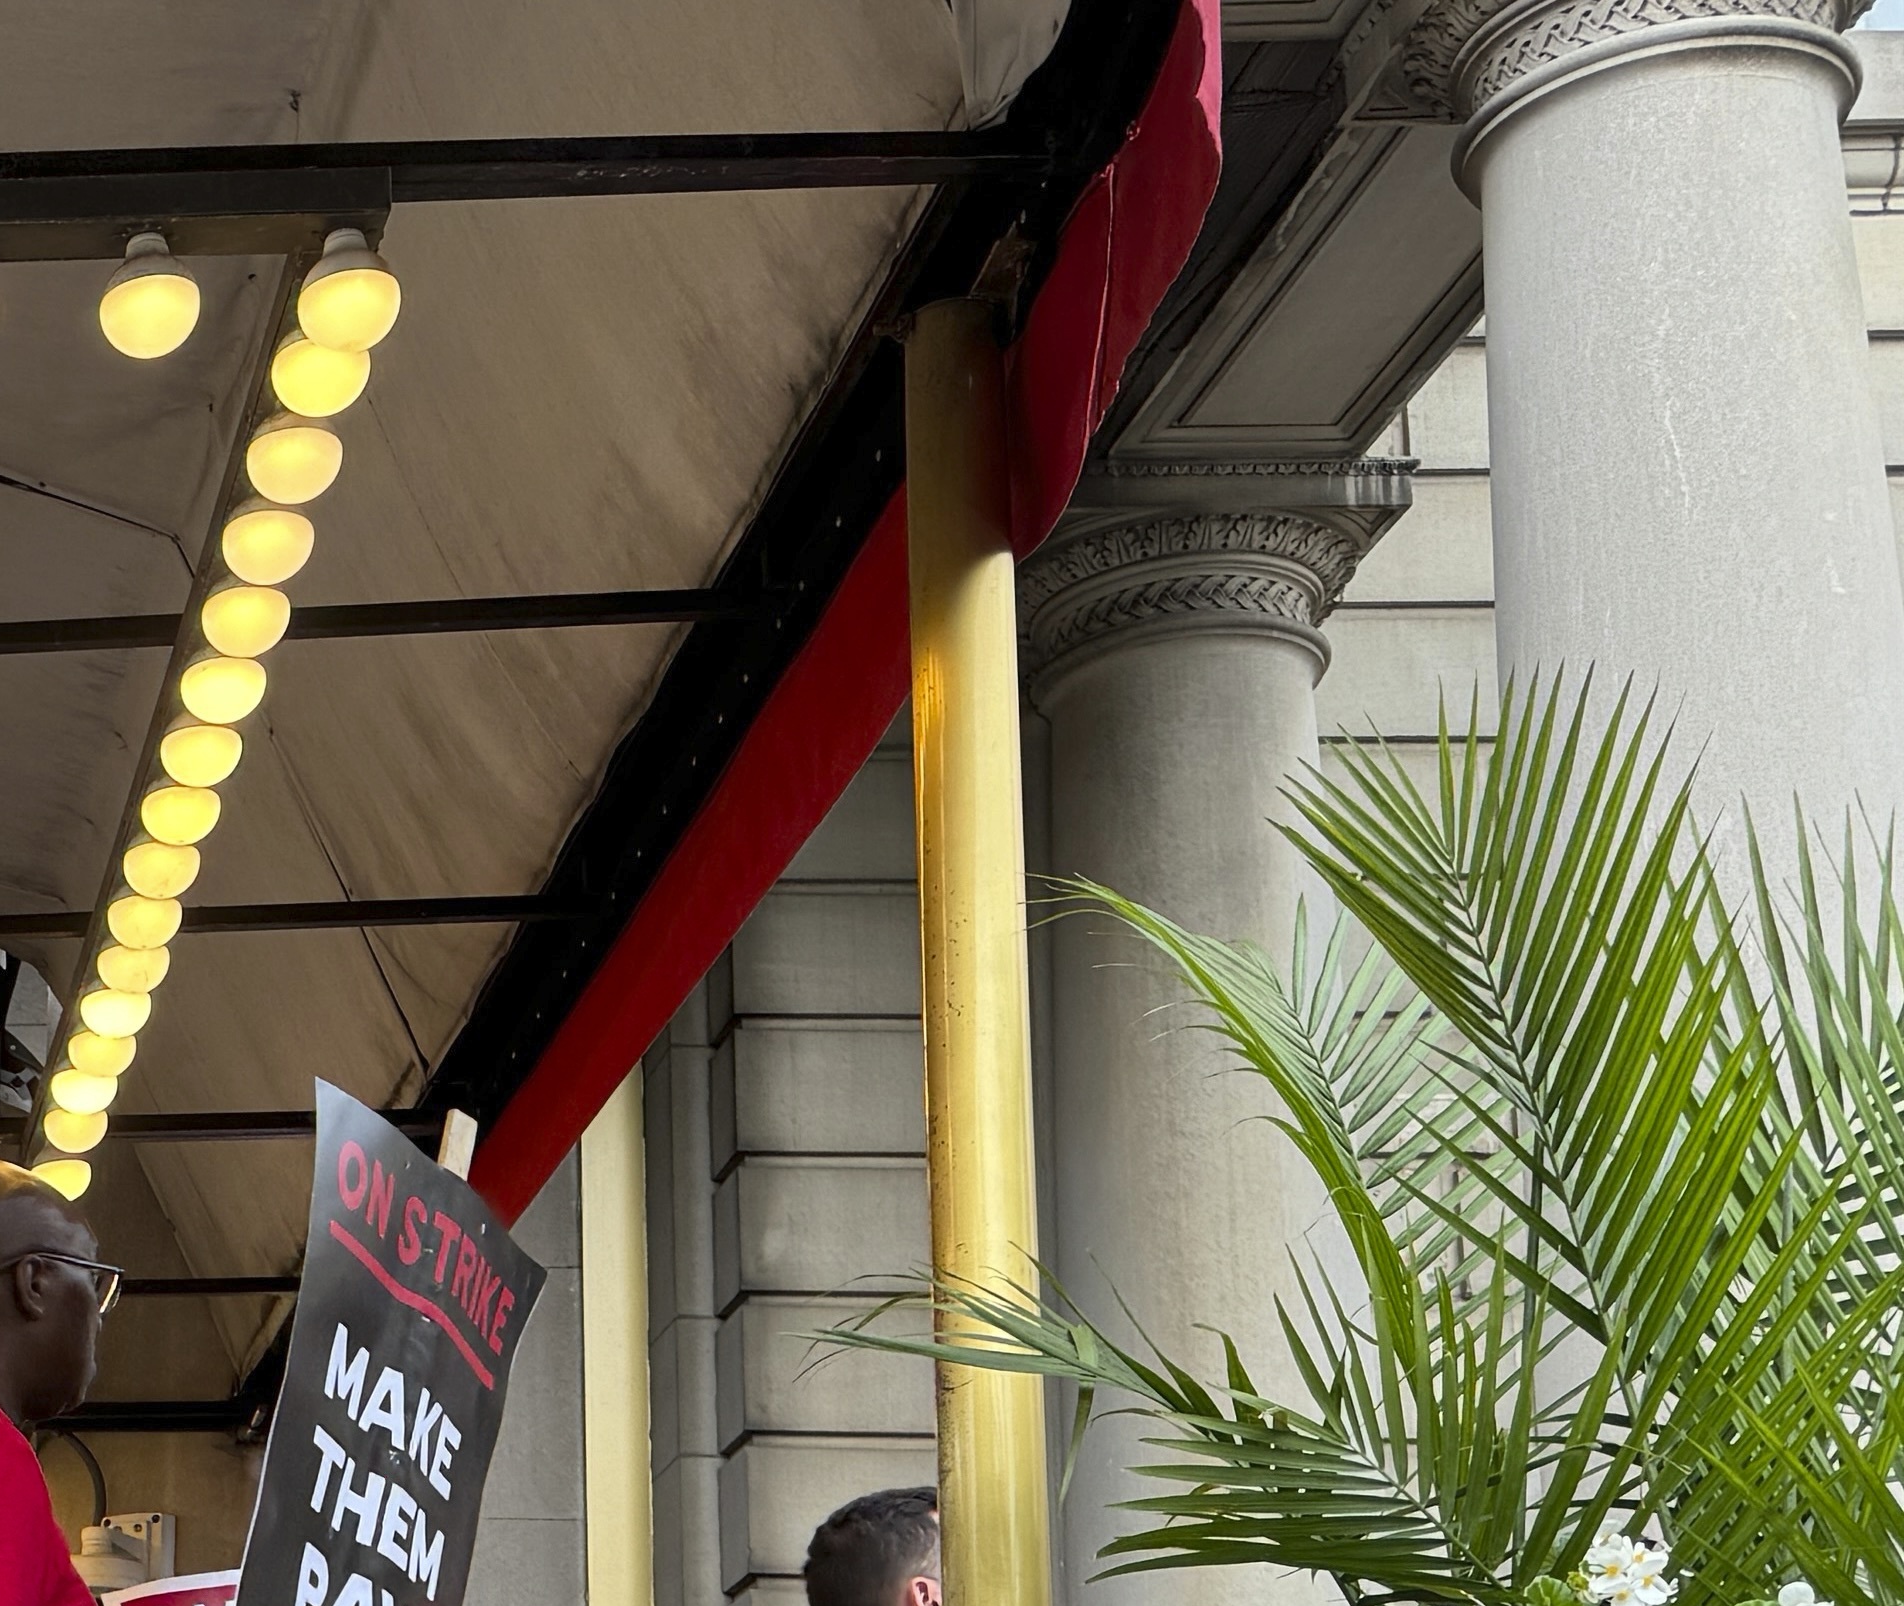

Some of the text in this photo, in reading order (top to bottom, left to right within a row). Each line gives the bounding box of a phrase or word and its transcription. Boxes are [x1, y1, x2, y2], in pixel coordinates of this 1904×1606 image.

[337, 1140, 515, 1356] ON STRIKE
[324, 1322, 462, 1500] MAKE
[310, 1425, 445, 1601] THEM
